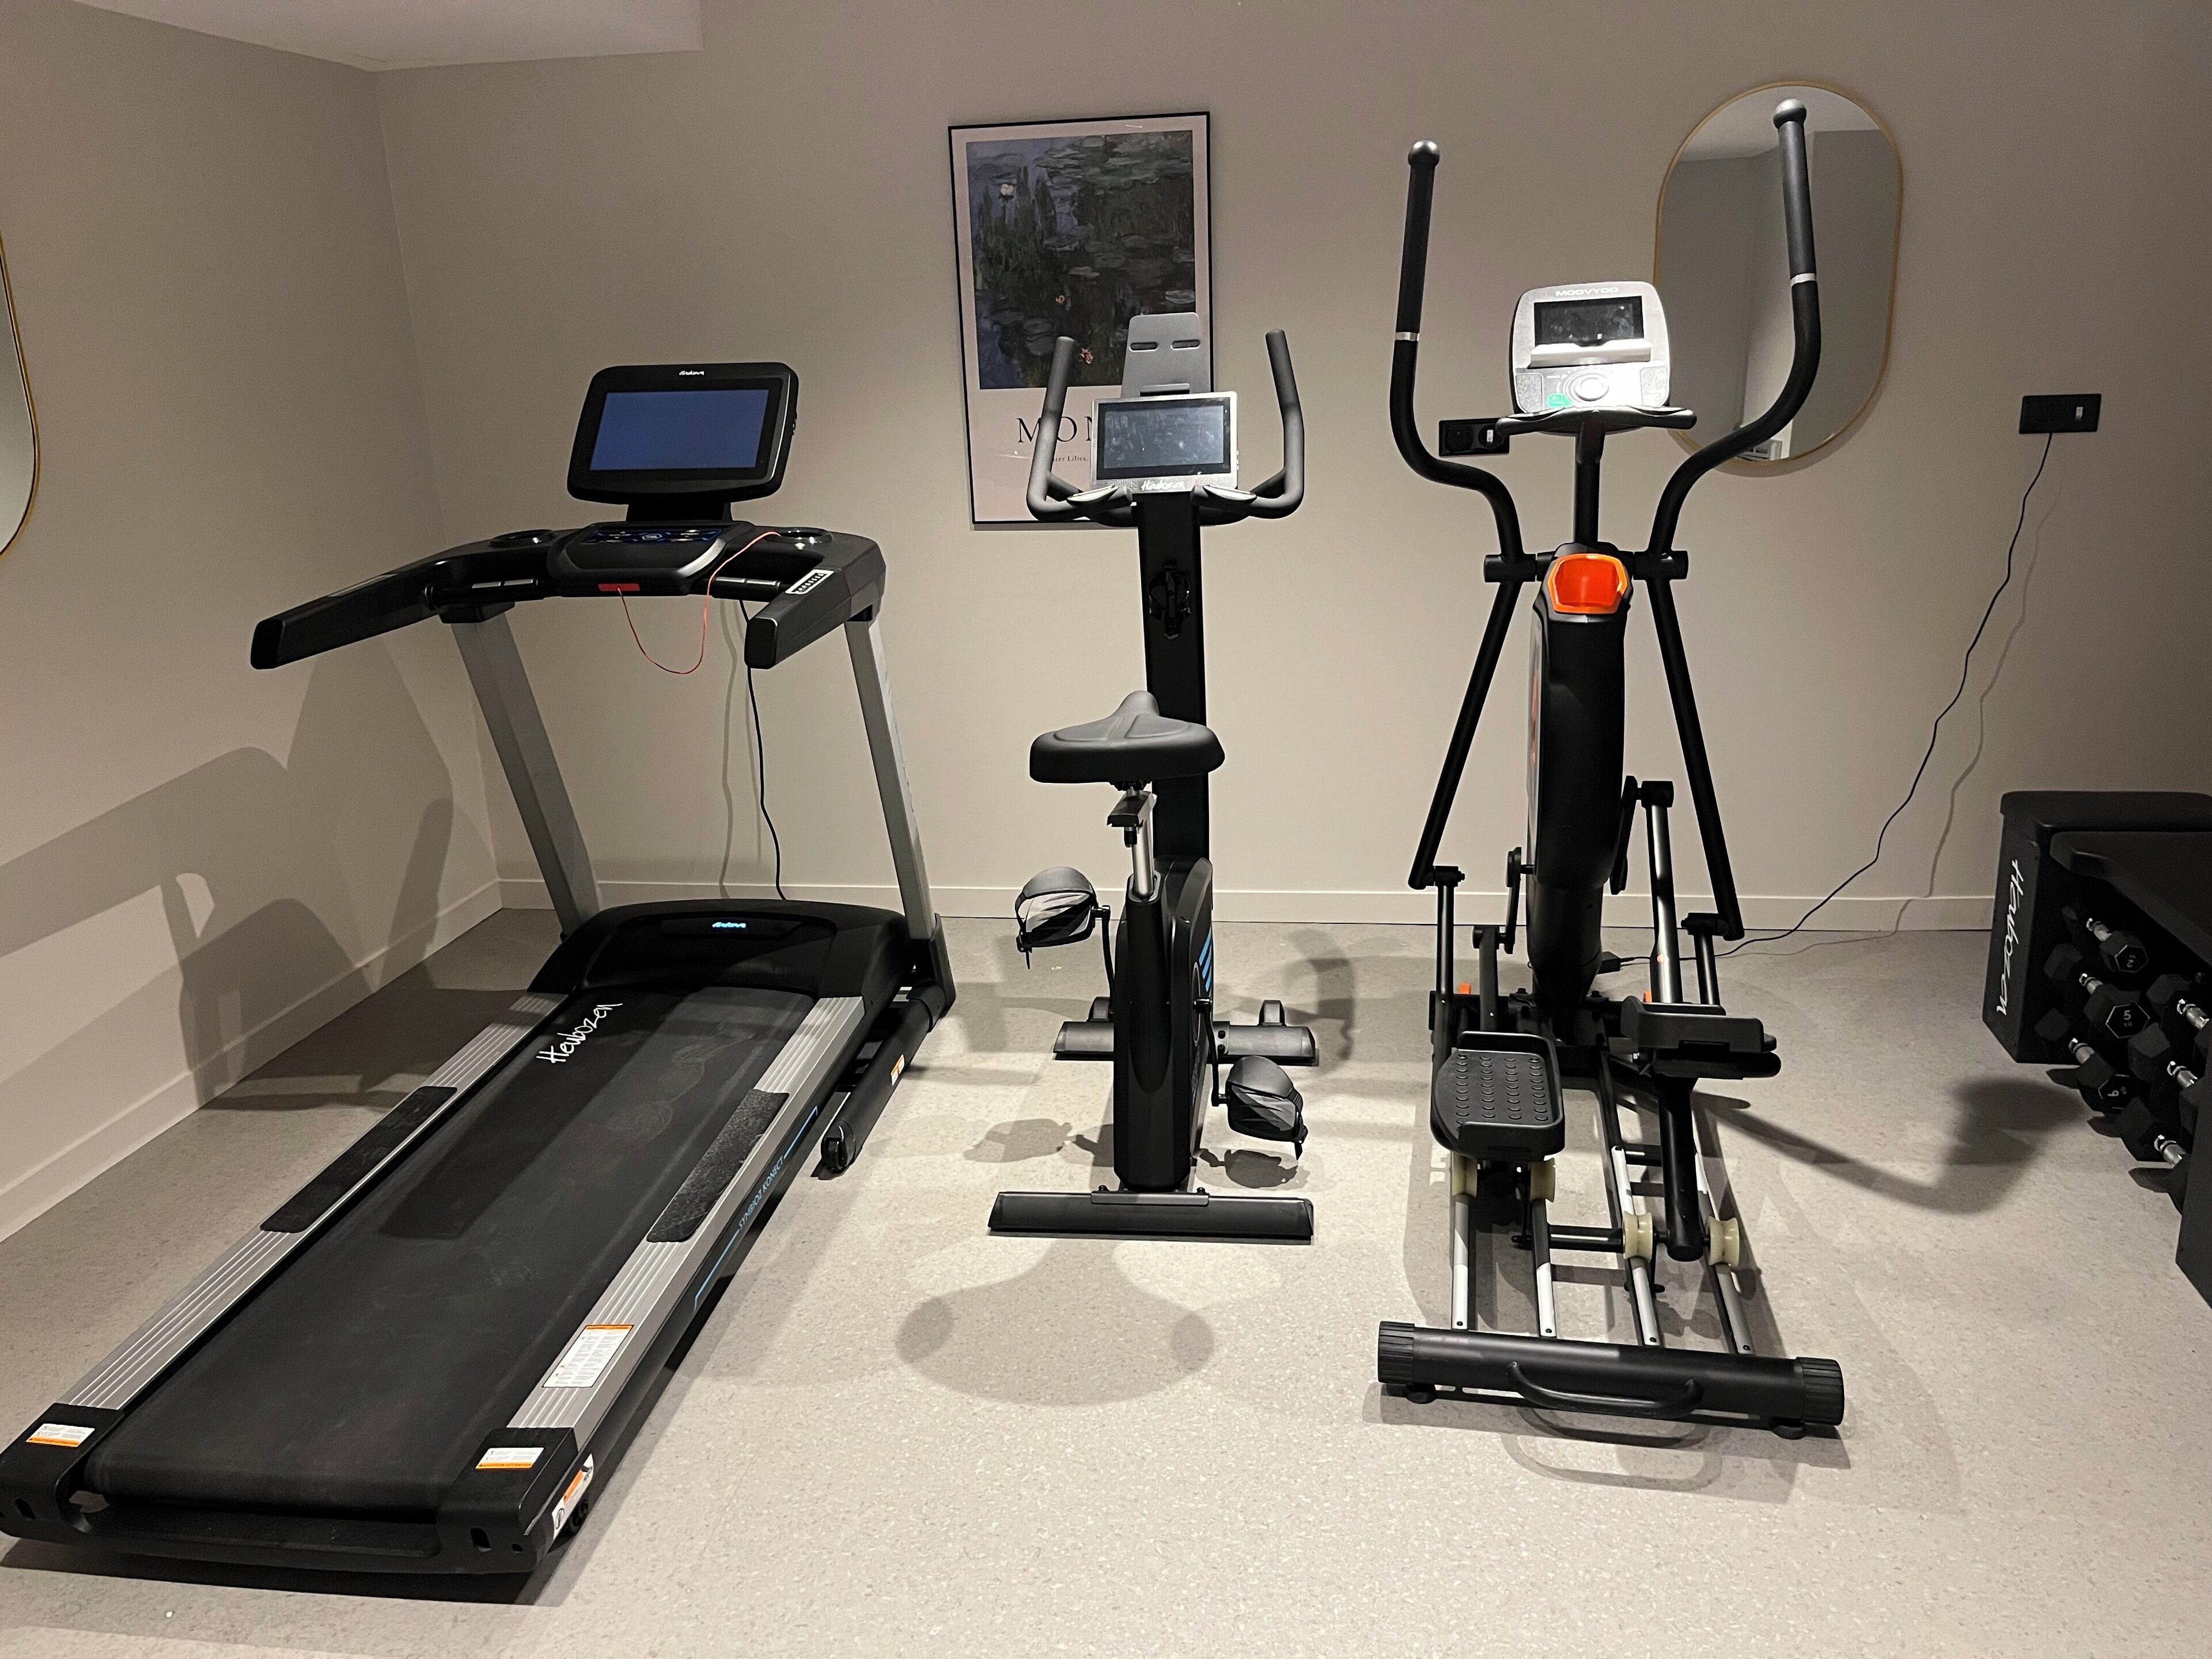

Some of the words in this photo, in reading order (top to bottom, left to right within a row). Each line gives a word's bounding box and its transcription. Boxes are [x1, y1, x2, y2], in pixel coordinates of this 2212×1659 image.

[1555, 287, 1619, 297] MOOVYOO
[1996, 859, 2024, 1016] Heubozen
[536, 1003, 623, 1063] Heubozen
[2123, 1010, 2131, 1020] 5
[762, 1155, 784, 1193] KONECT
